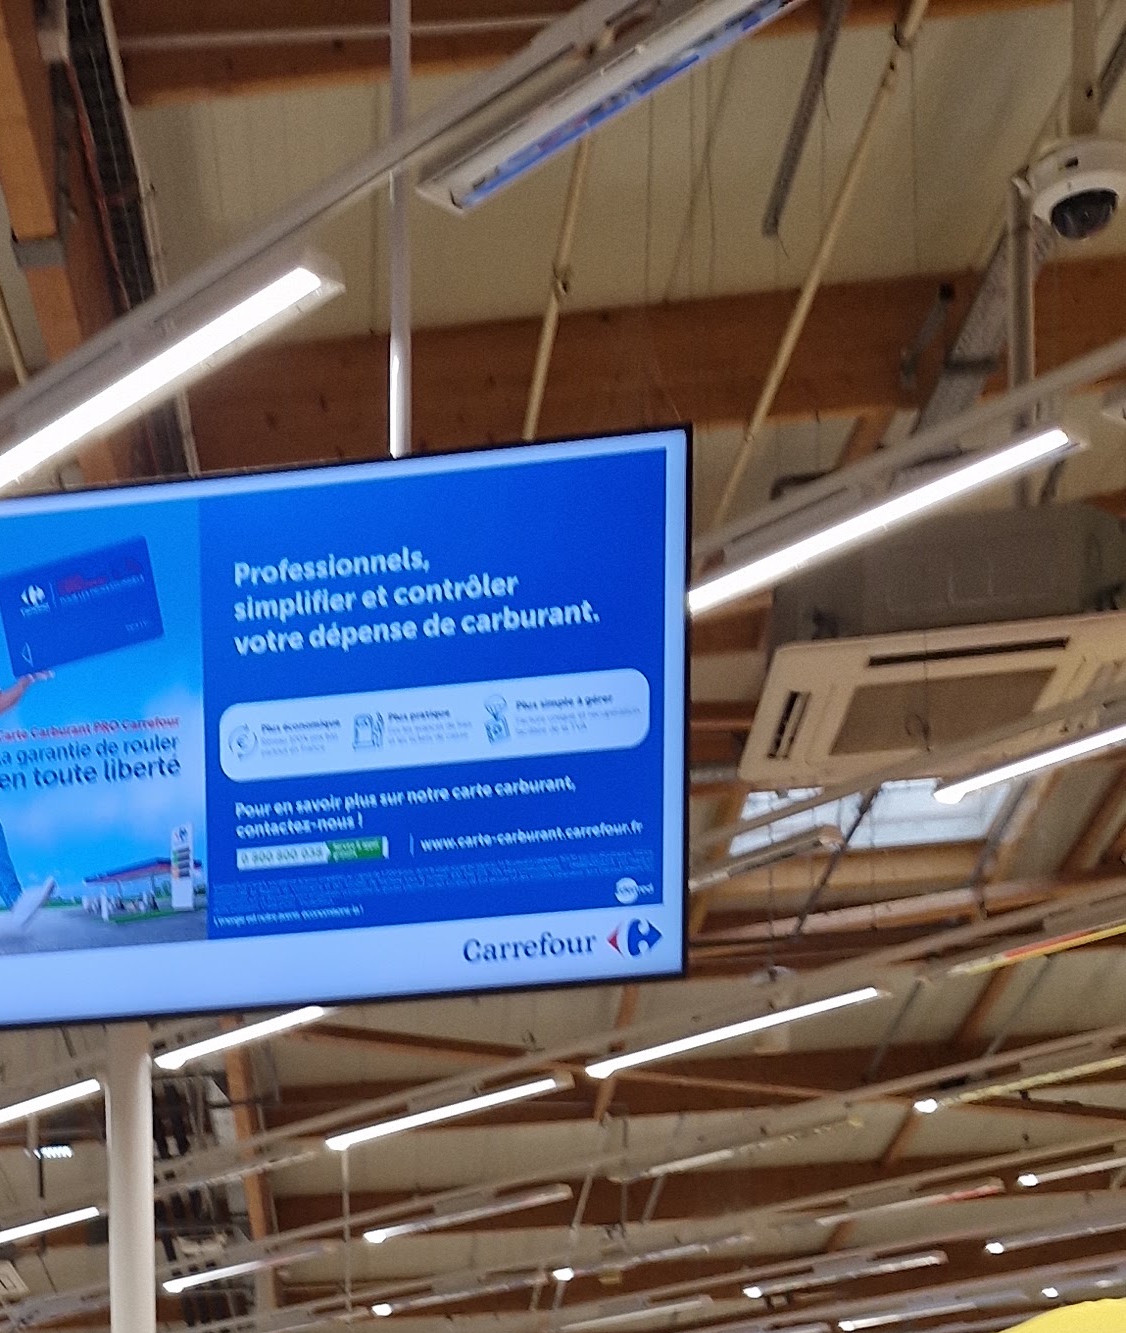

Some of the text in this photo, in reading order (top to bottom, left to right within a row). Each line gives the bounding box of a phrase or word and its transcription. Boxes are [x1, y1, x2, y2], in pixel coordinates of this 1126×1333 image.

[234, 546, 429, 588] Professionnels,
[233, 572, 519, 623] simplifier et contrôler
[233, 599, 601, 656] votre dépense de carburant.
[17, 740, 92, 766] garantie
[95, 737, 119, 756] de
[123, 733, 179, 753] rouler
[33, 763, 97, 790] toute
[103, 754, 181, 783] liberté
[234, 775, 577, 820] Pour en savoir plus sur notre carte carburant,
[235, 814, 356, 839] contactez-nous
[420, 819, 644, 853] www.carte-carburant.carrefour.fr
[463, 931, 600, 964] Carrefour
